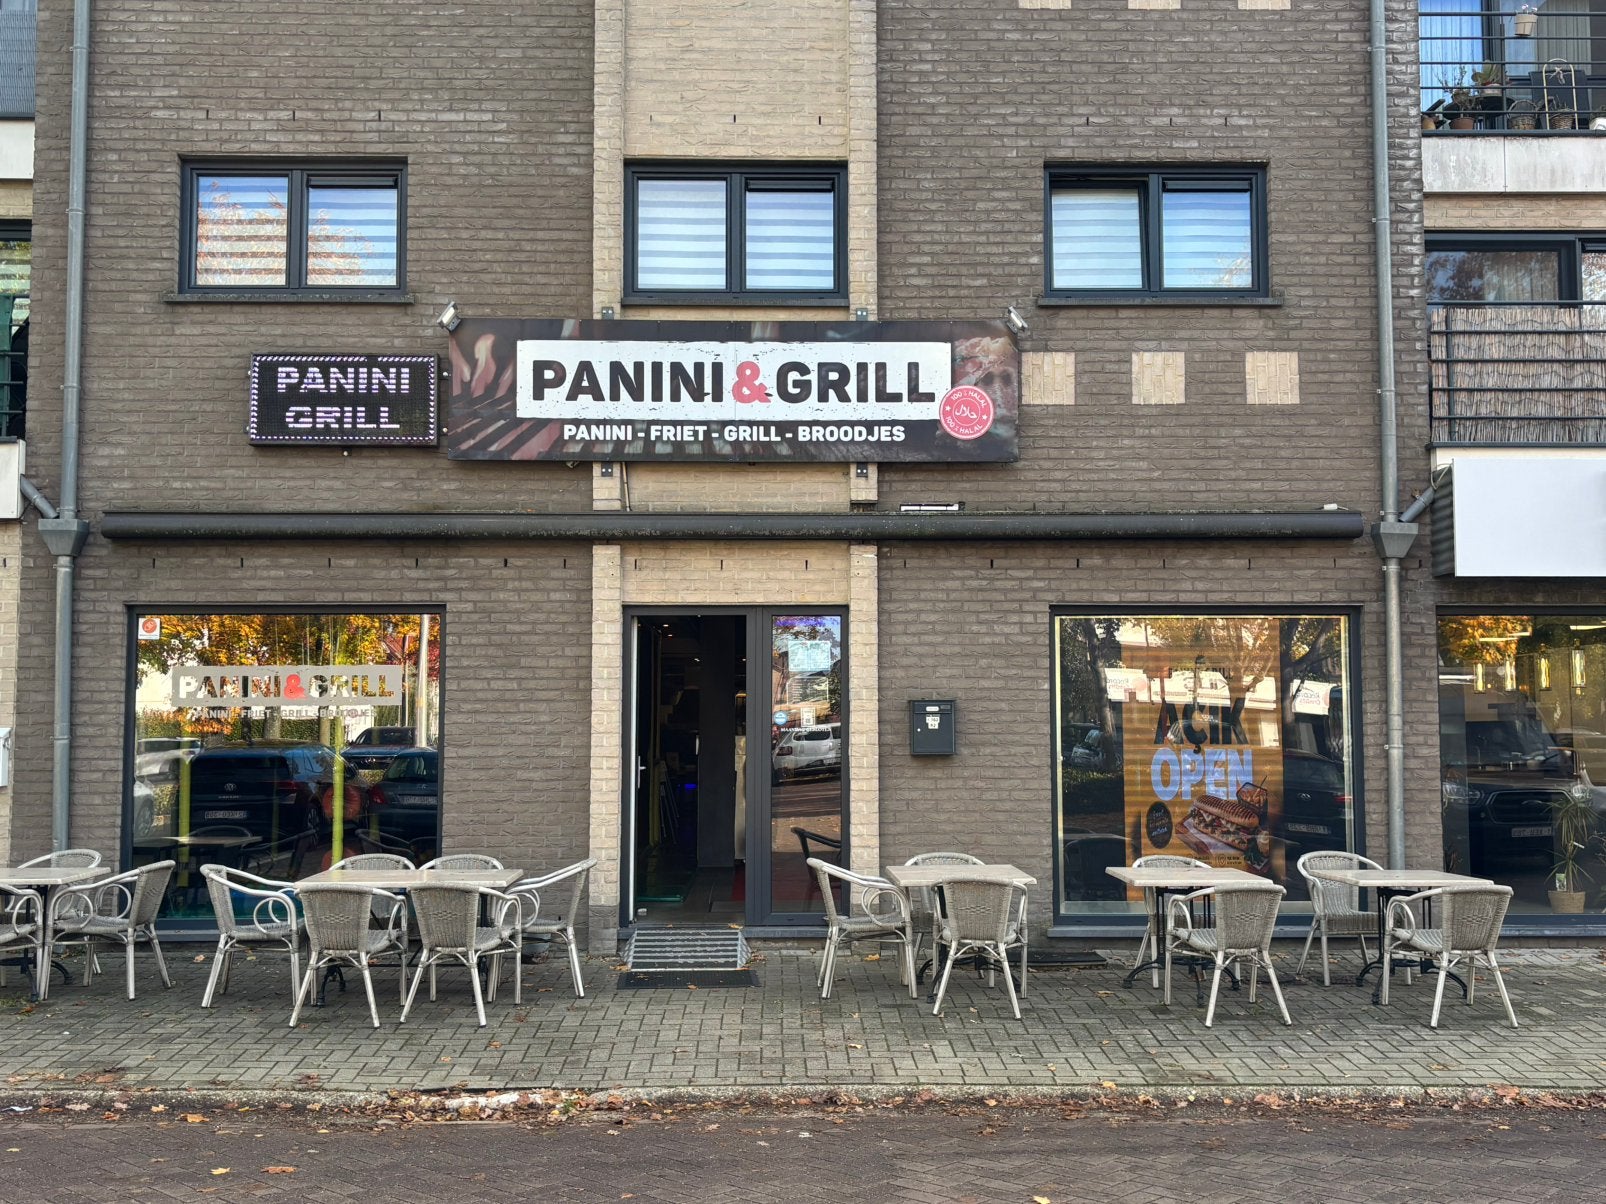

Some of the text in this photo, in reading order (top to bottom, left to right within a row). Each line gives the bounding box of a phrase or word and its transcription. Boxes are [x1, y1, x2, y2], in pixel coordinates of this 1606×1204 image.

[277, 367, 410, 393] PANINI
[969, 391, 986, 407] HALAL
[285, 406, 400, 428] GRILL
[563, 425, 633, 441] PANINI
[650, 425, 707, 441] FRIET
[723, 425, 781, 442] GRILL
[798, 425, 906, 442] BROODJES
[960, 424, 982, 434] HALAL
[195, 708, 232, 718] PANINI
[241, 708, 271, 718] FRIET
[281, 709, 310, 718] GRILL
[1154, 697, 1250, 754] AÇIK
[1151, 747, 1253, 801] OPEN
